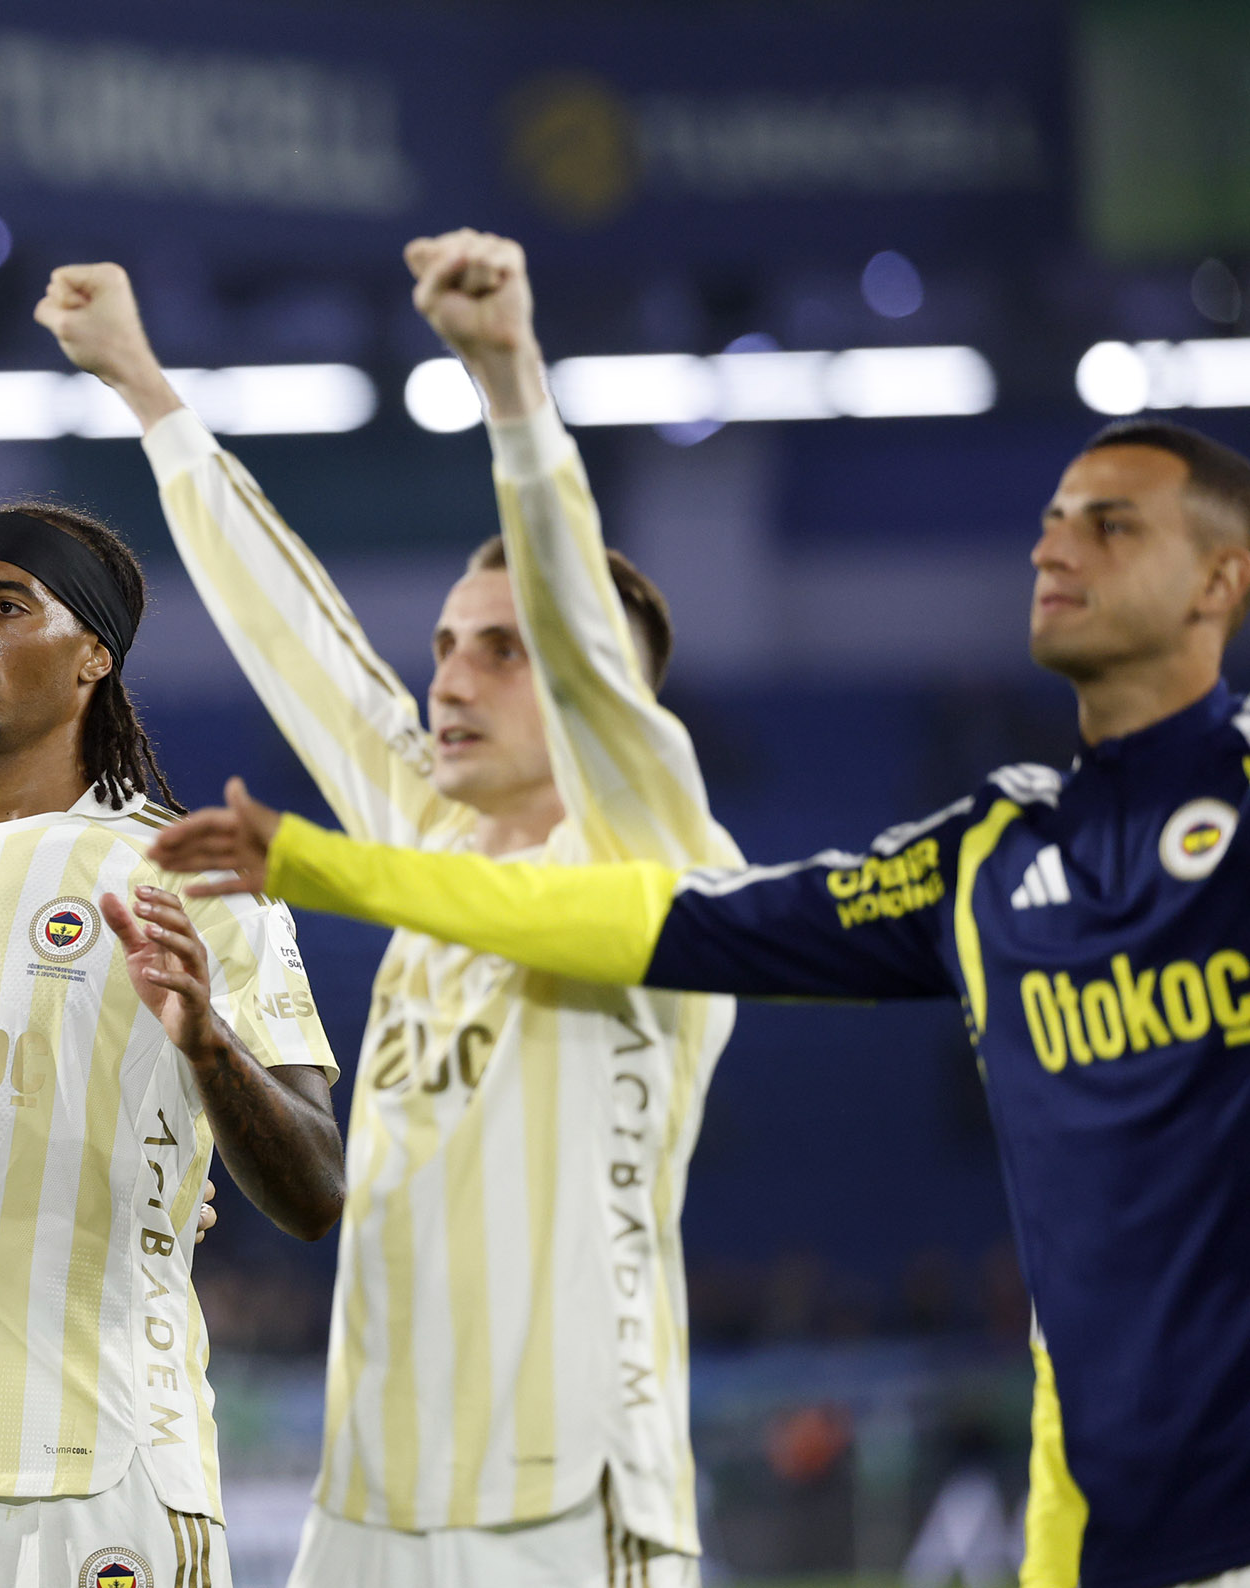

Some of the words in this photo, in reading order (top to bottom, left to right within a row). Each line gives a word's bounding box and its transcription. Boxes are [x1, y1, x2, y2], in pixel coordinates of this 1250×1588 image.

[37, 904, 69, 938] FENERBAHÇE
[70, 904, 87, 918] SPOR
[1020, 949, 1250, 1074] Otokoç
[114, 1556, 135, 1568] SPOR
